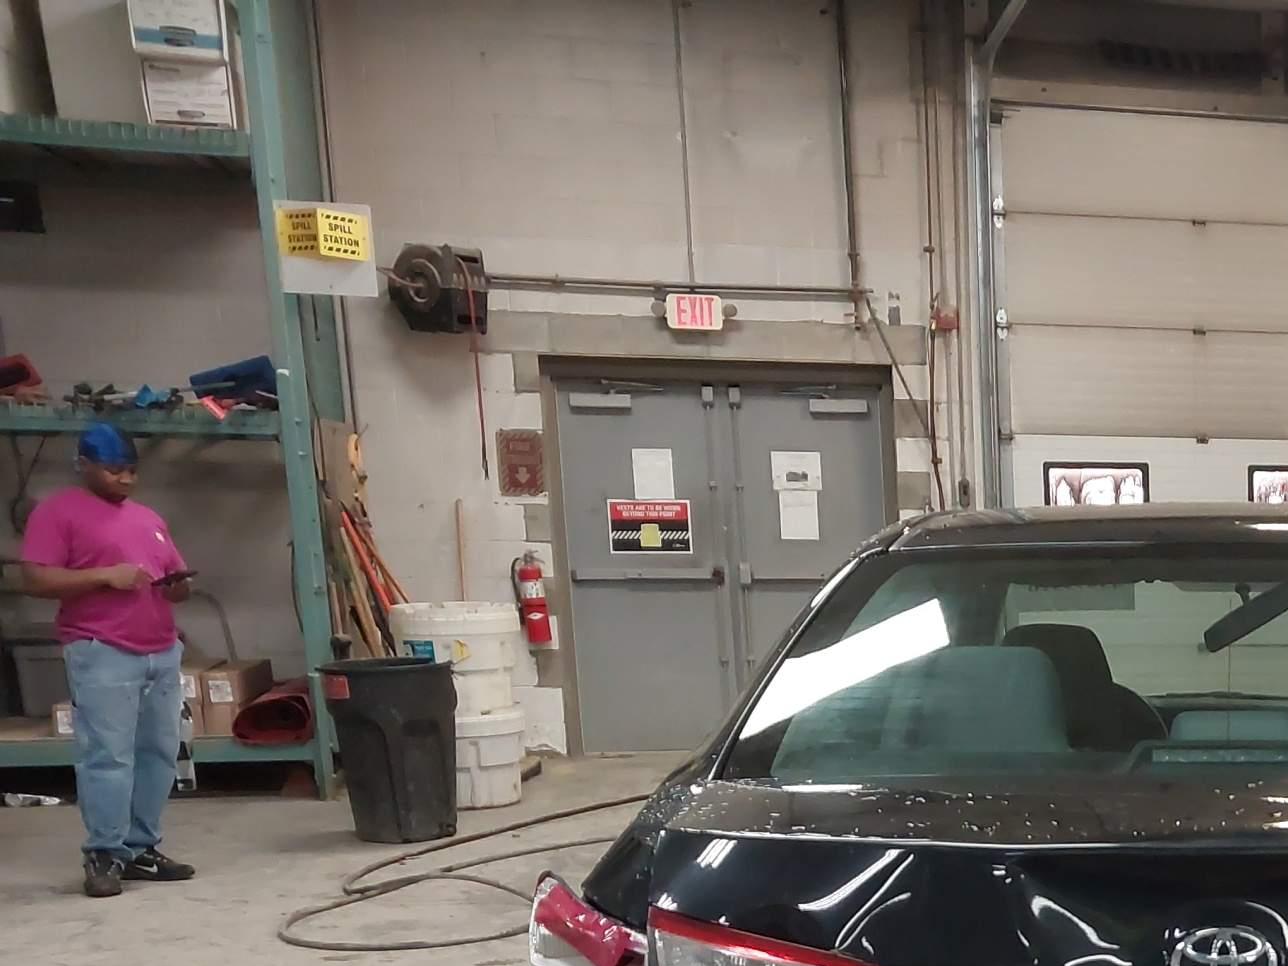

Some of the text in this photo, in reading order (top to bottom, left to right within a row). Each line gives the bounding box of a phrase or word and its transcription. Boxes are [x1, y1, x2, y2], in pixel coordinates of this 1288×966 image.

[328, 222, 353, 235] SPILL
[323, 234, 360, 248] STATION
[676, 295, 714, 327] EXIT
